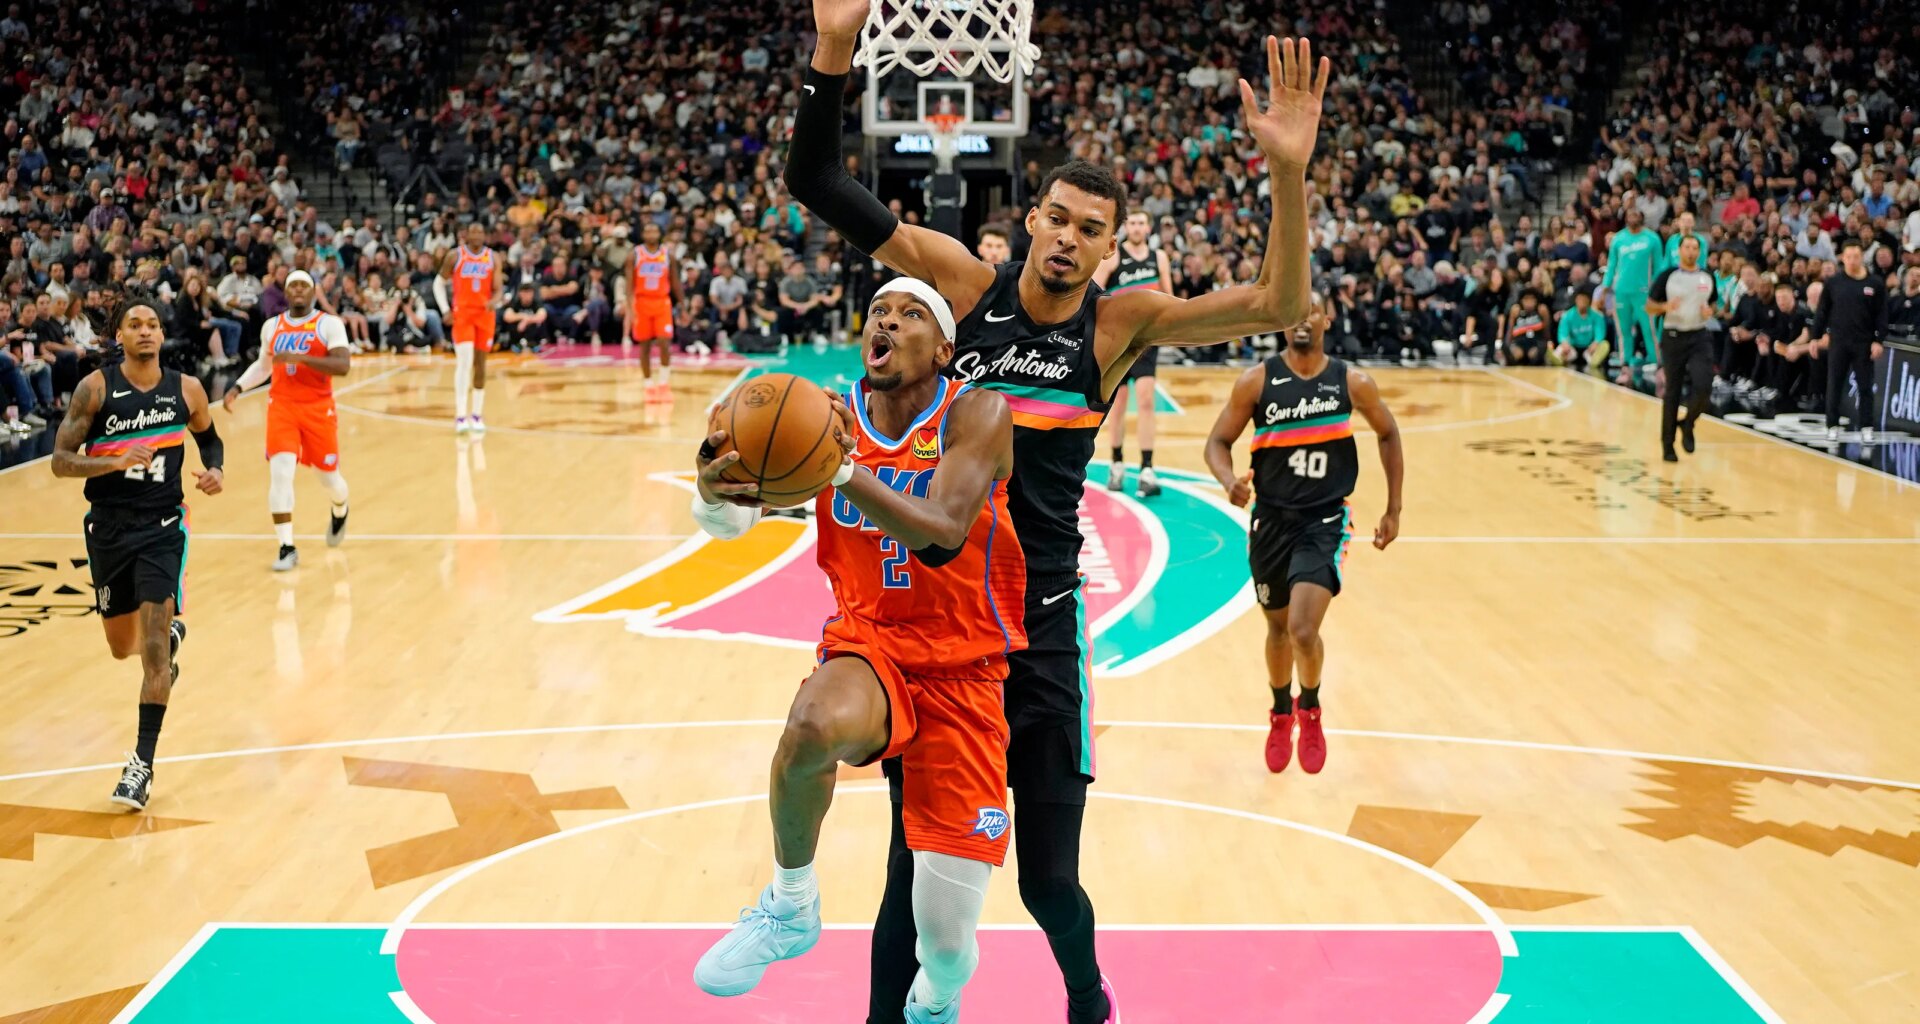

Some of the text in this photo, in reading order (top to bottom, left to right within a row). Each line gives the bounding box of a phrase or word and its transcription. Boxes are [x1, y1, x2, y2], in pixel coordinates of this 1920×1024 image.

[273, 332, 316, 354] OKC
[1053, 334, 1078, 347] LEDGER
[989, 344, 1072, 380] Antonio
[105, 407, 176, 435] San Antonio
[1265, 396, 1340, 425] San Antonio
[124, 455, 166, 482] 24
[1288, 448, 1328, 479] 40
[880, 535, 911, 589] 2
